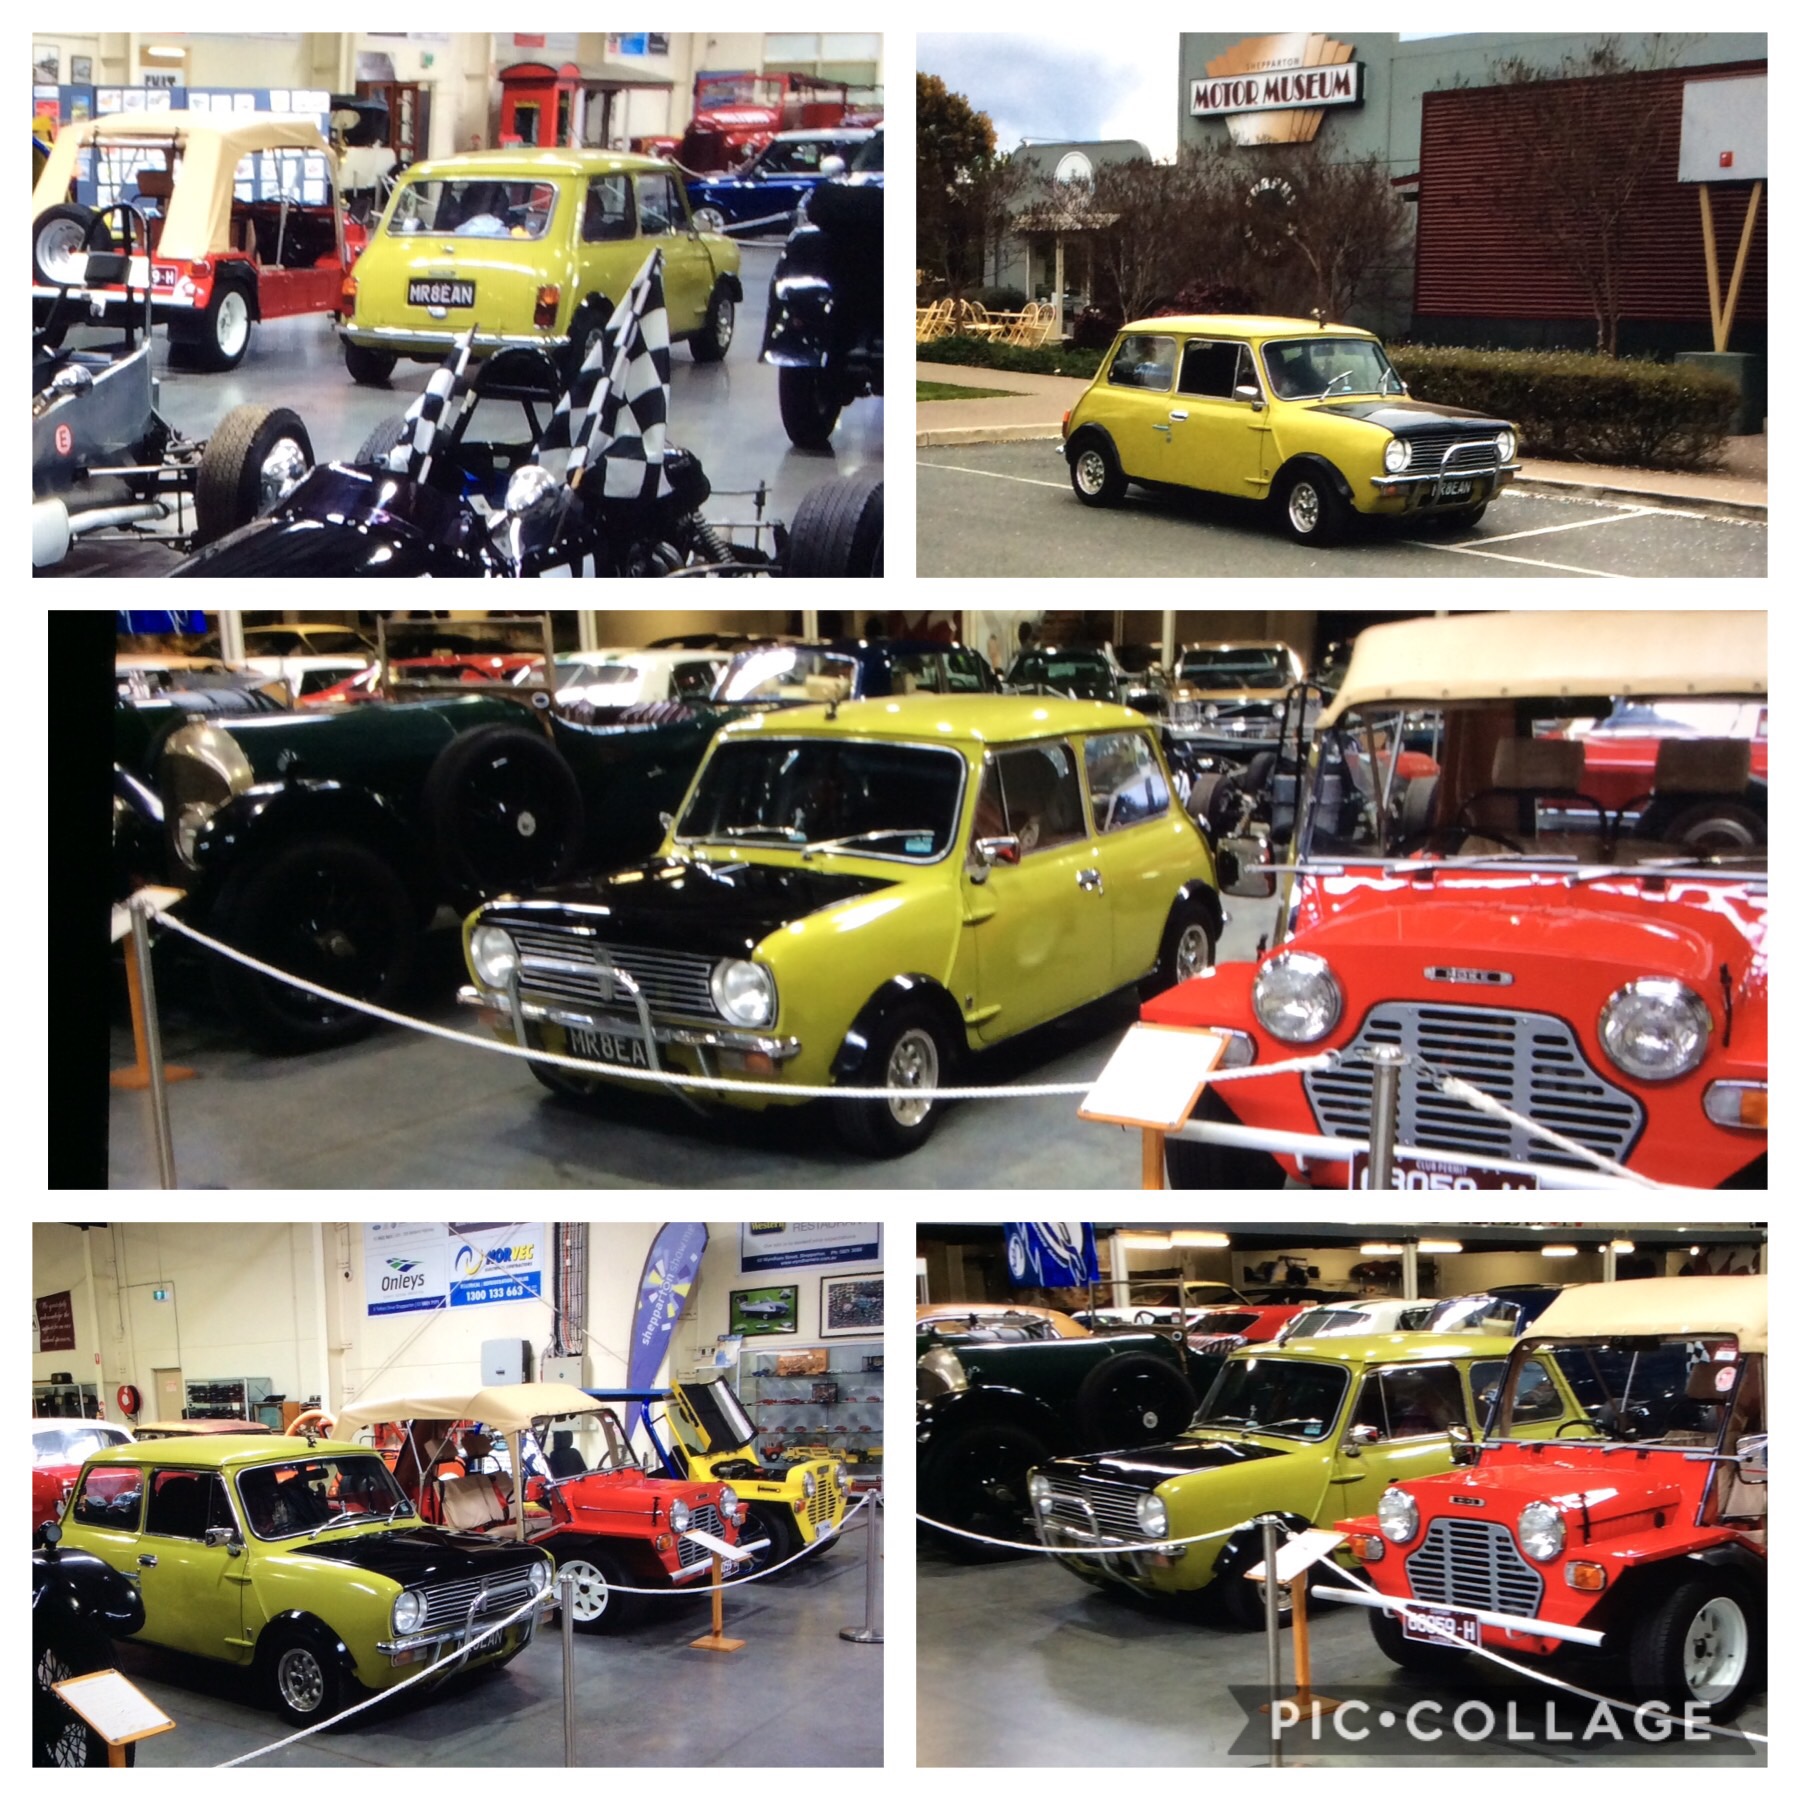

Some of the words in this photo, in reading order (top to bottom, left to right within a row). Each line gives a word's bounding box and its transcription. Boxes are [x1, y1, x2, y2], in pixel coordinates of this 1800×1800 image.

[1246, 57, 1300, 71] SHEPPARTON
[1193, 80, 1259, 110] MOTOR
[1262, 68, 1352, 105] MUSEUM
[409, 283, 473, 304] MR8EAN
[570, 1027, 651, 1067] MR8EA
[486, 1243, 534, 1265] NORVEC
[381, 1273, 425, 1292] Onleys
[466, 1289, 487, 1302] 1300
[489, 1287, 504, 1299] 133
[506, 1286, 524, 1297] 663
[642, 1273, 675, 1346] shepparton
